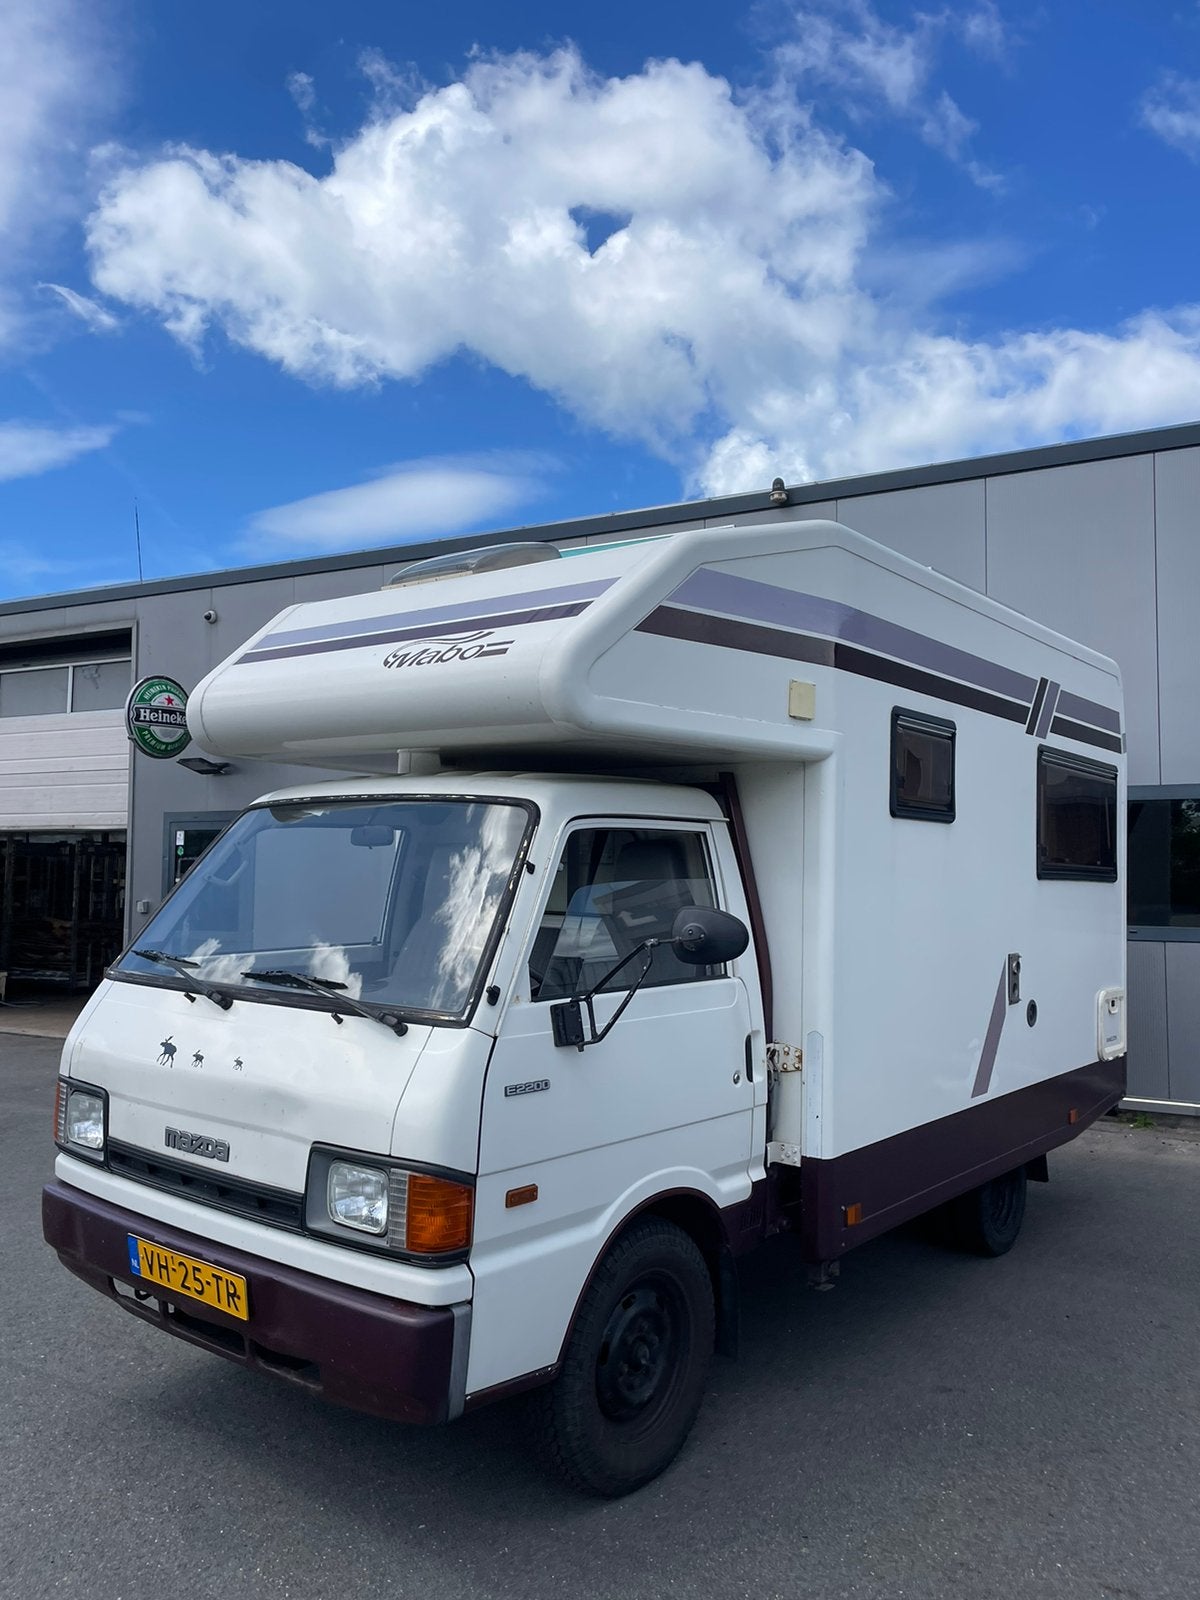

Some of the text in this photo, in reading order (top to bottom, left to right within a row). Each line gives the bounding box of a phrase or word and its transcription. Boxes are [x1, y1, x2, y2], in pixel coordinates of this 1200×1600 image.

[384, 643, 486, 668] Mabo
[139, 708, 187, 725] Heineke
[141, 730, 167, 751] PREMIUM
[504, 1079, 550, 1097] E2200
[143, 1247, 240, 1312] VH-25-TR
